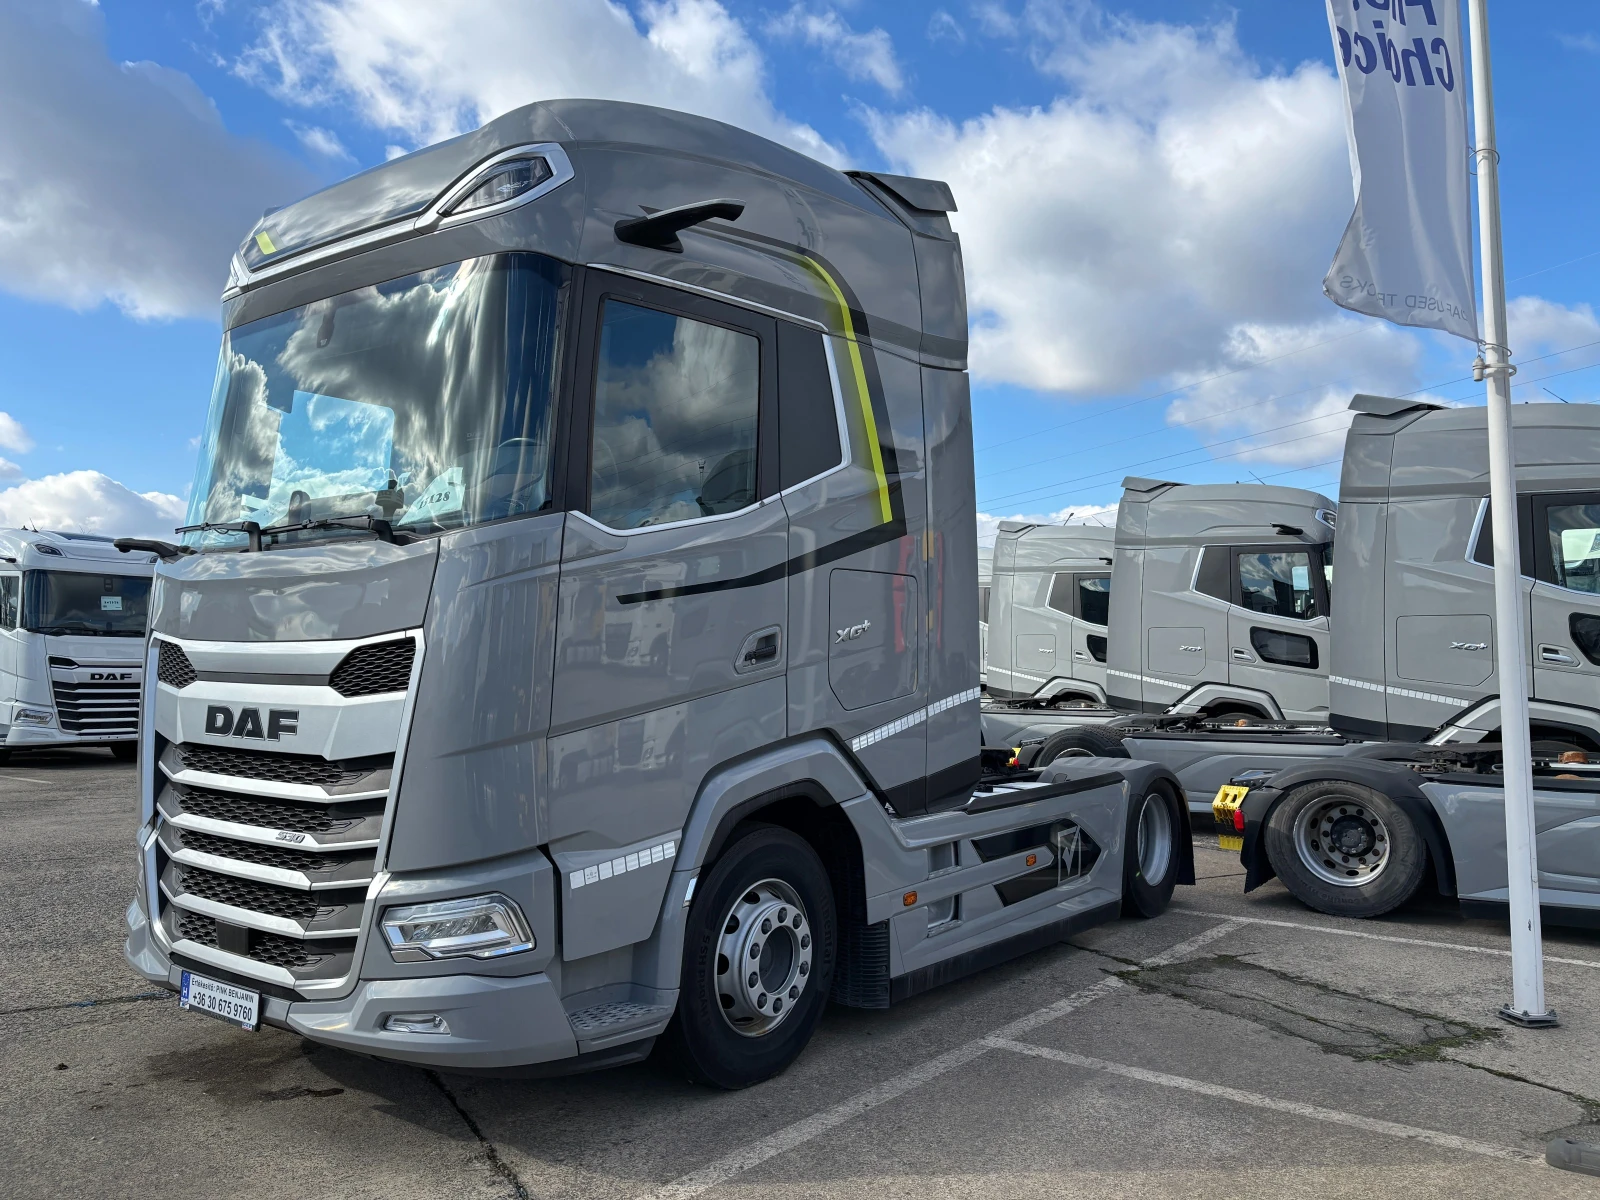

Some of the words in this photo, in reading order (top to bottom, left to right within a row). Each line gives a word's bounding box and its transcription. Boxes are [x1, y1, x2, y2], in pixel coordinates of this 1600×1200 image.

[835, 619, 871, 644] XG+
[90, 672, 133, 681] DAF
[205, 704, 299, 742] DAF
[276, 831, 305, 844] 530
[216, 985, 227, 996] PINK
[228, 988, 254, 1003] BENJAMIN
[193, 992, 206, 1006] +36
[207, 995, 217, 1010] 30
[217, 999, 232, 1015] 675
[233, 1003, 252, 1021] 9760
